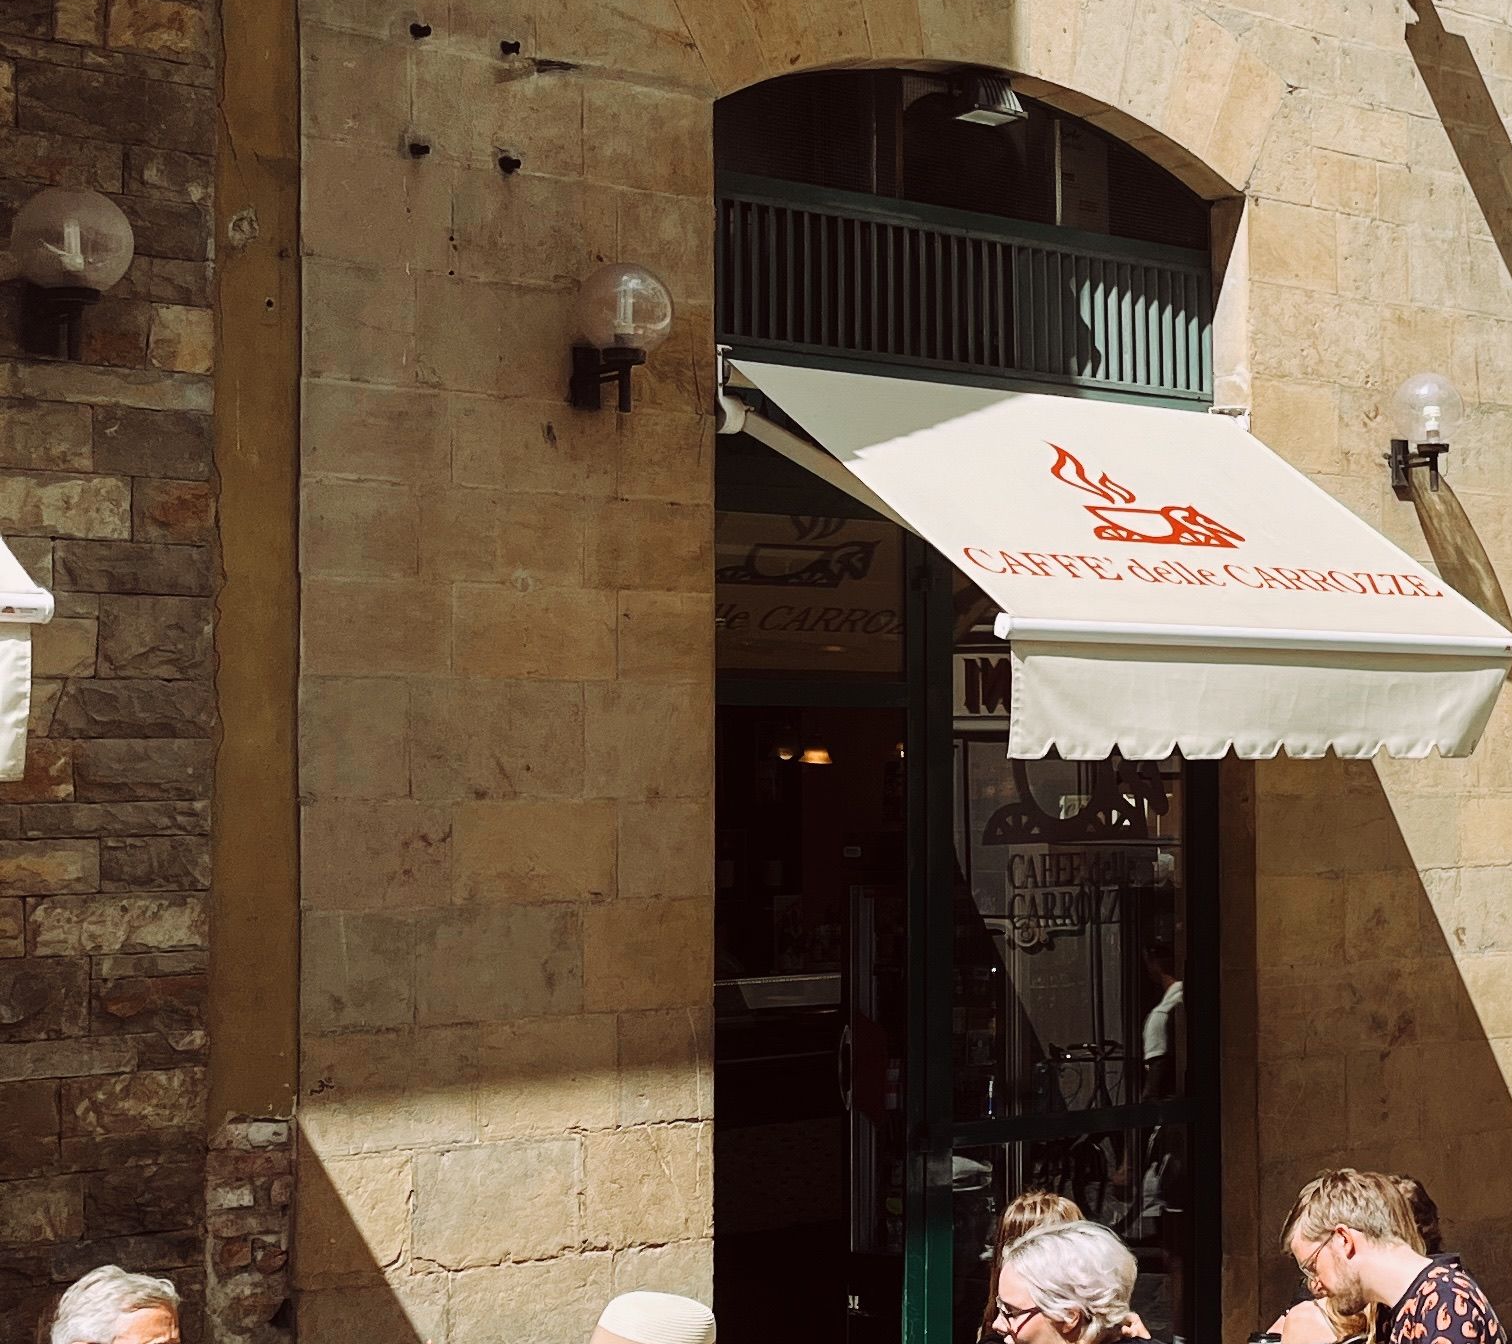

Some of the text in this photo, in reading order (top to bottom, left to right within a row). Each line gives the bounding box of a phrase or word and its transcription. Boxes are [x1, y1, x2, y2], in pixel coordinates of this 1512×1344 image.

[962, 545, 1445, 600] CAFFE' delle CARROZZE
